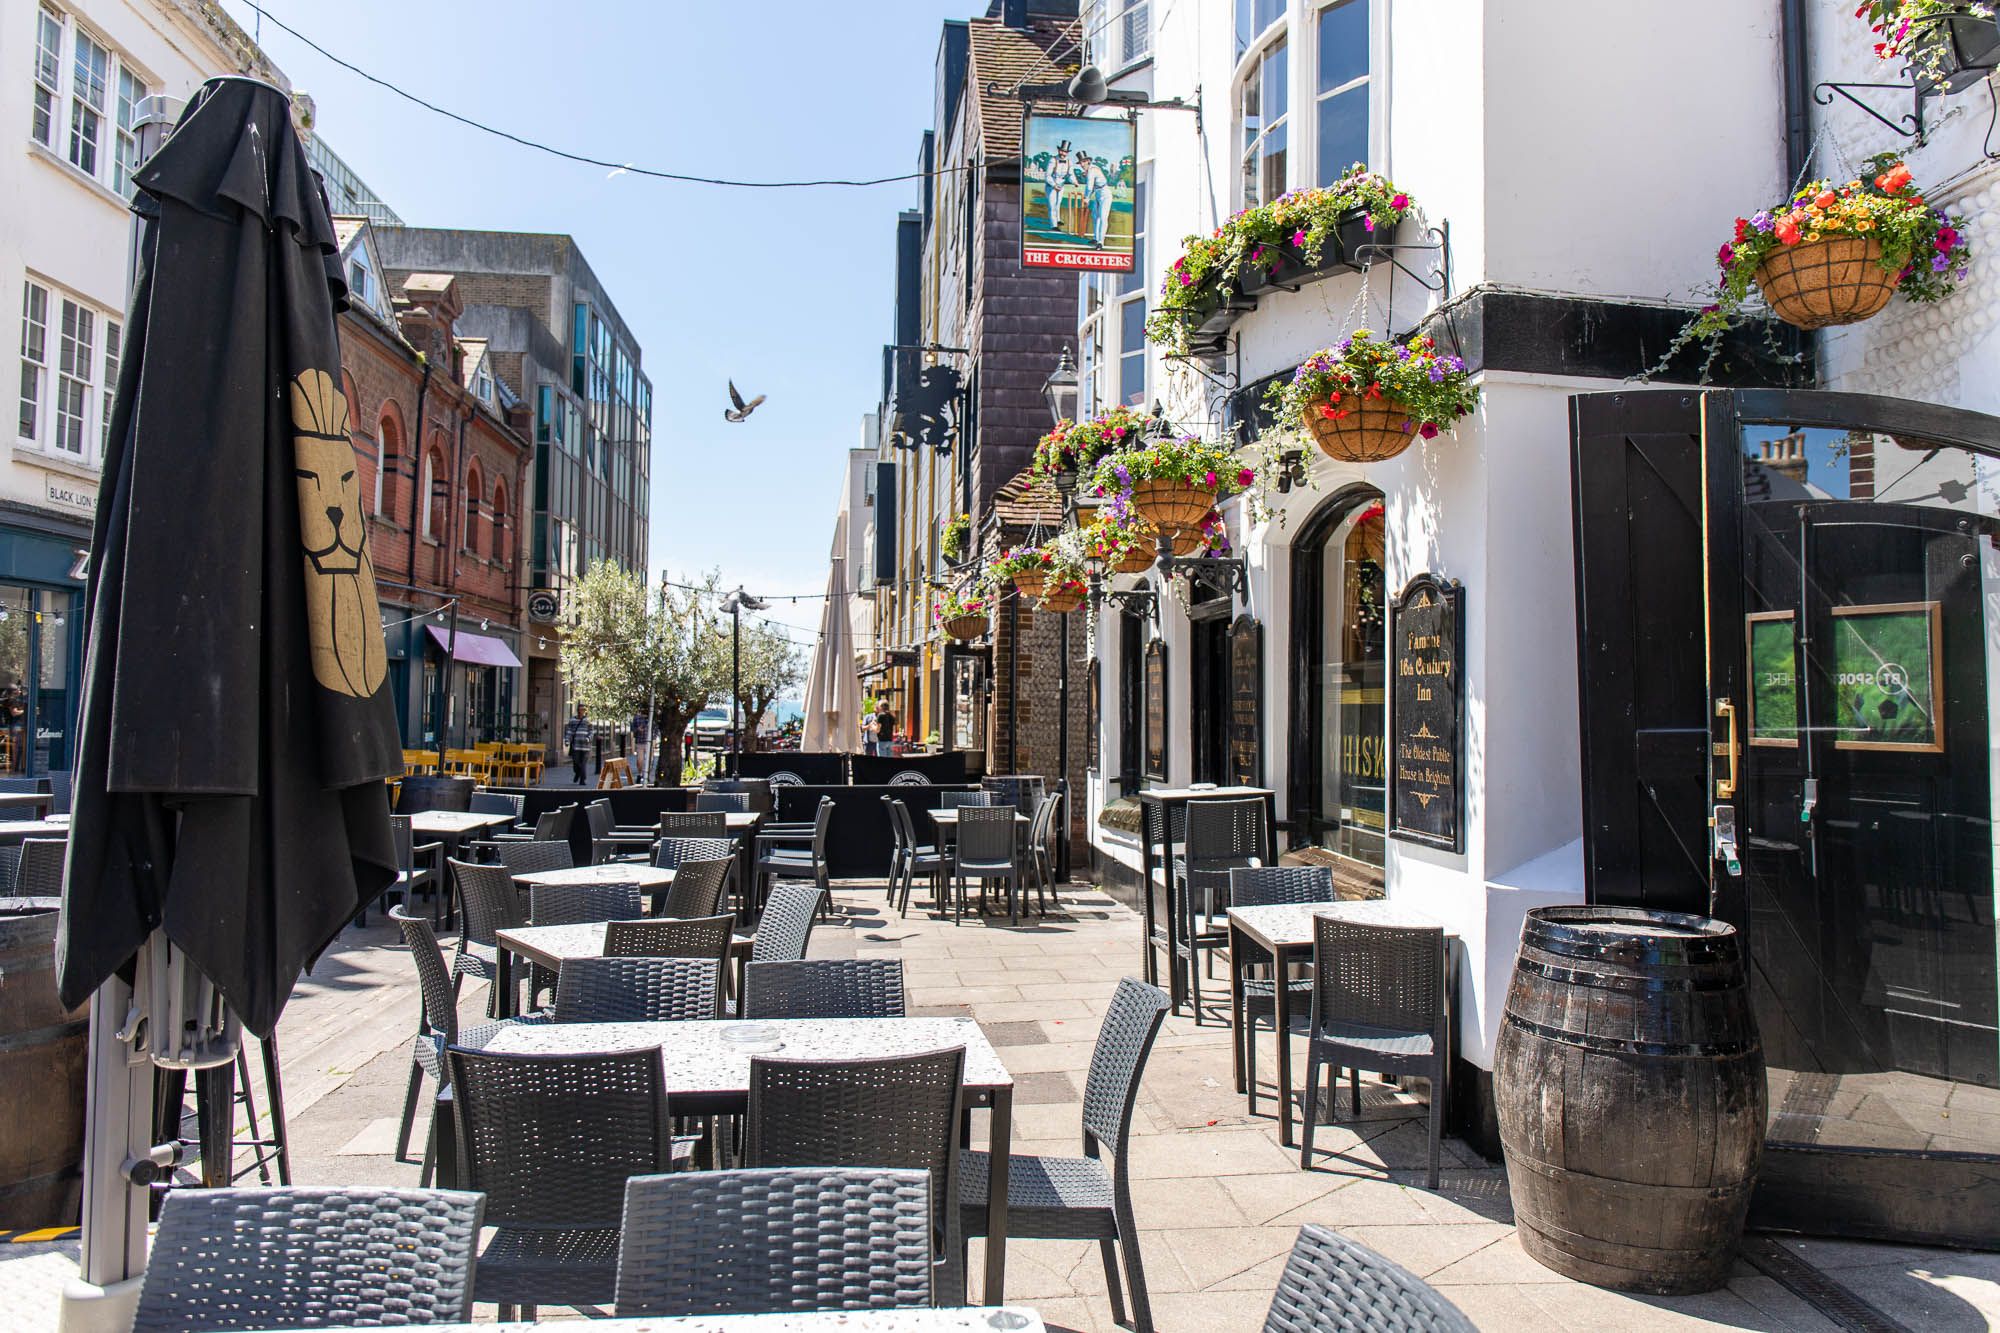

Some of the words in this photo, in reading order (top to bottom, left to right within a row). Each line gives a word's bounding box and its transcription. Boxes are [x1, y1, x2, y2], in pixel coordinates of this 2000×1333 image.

[1025, 252, 1050, 263] THE
[1055, 254, 1131, 267] CRICKETERS
[50, 487, 74, 503] BLACK
[76, 494, 92, 507] LION
[1399, 657, 1414, 676] 16th
[1415, 656, 1451, 678] Century
[1416, 683, 1432, 701] Inn
[1400, 743, 1412, 759] The
[1413, 745, 1431, 760] Oldest
[1432, 745, 1451, 763] Public
[1399, 764, 1417, 780] House
[1418, 769, 1424, 782] in
[1425, 767, 1451, 791] Brighton
